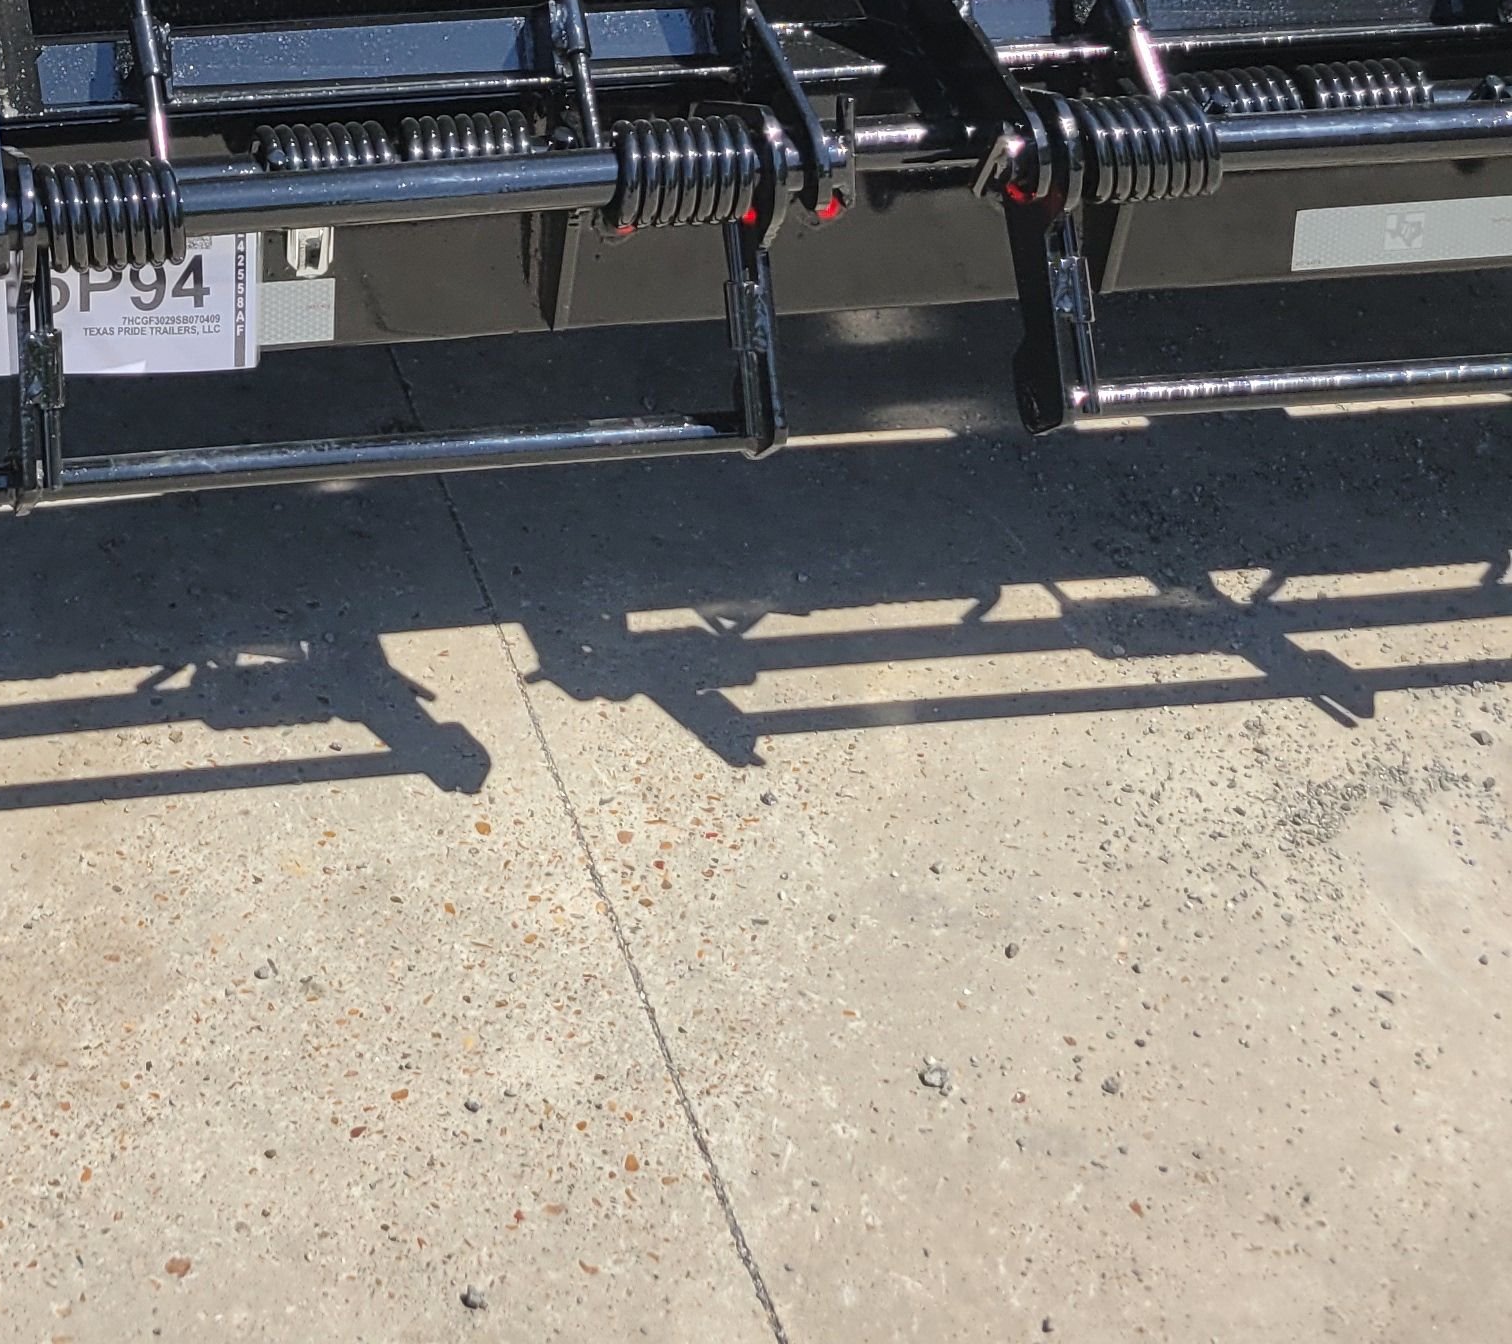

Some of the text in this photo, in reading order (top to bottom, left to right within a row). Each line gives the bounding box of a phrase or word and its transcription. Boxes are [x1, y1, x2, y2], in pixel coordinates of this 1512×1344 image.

[122, 313, 221, 326] 7HCGF3029SB070409
[82, 323, 221, 337] TEXAS PRIDE TRAILERS, LLC
